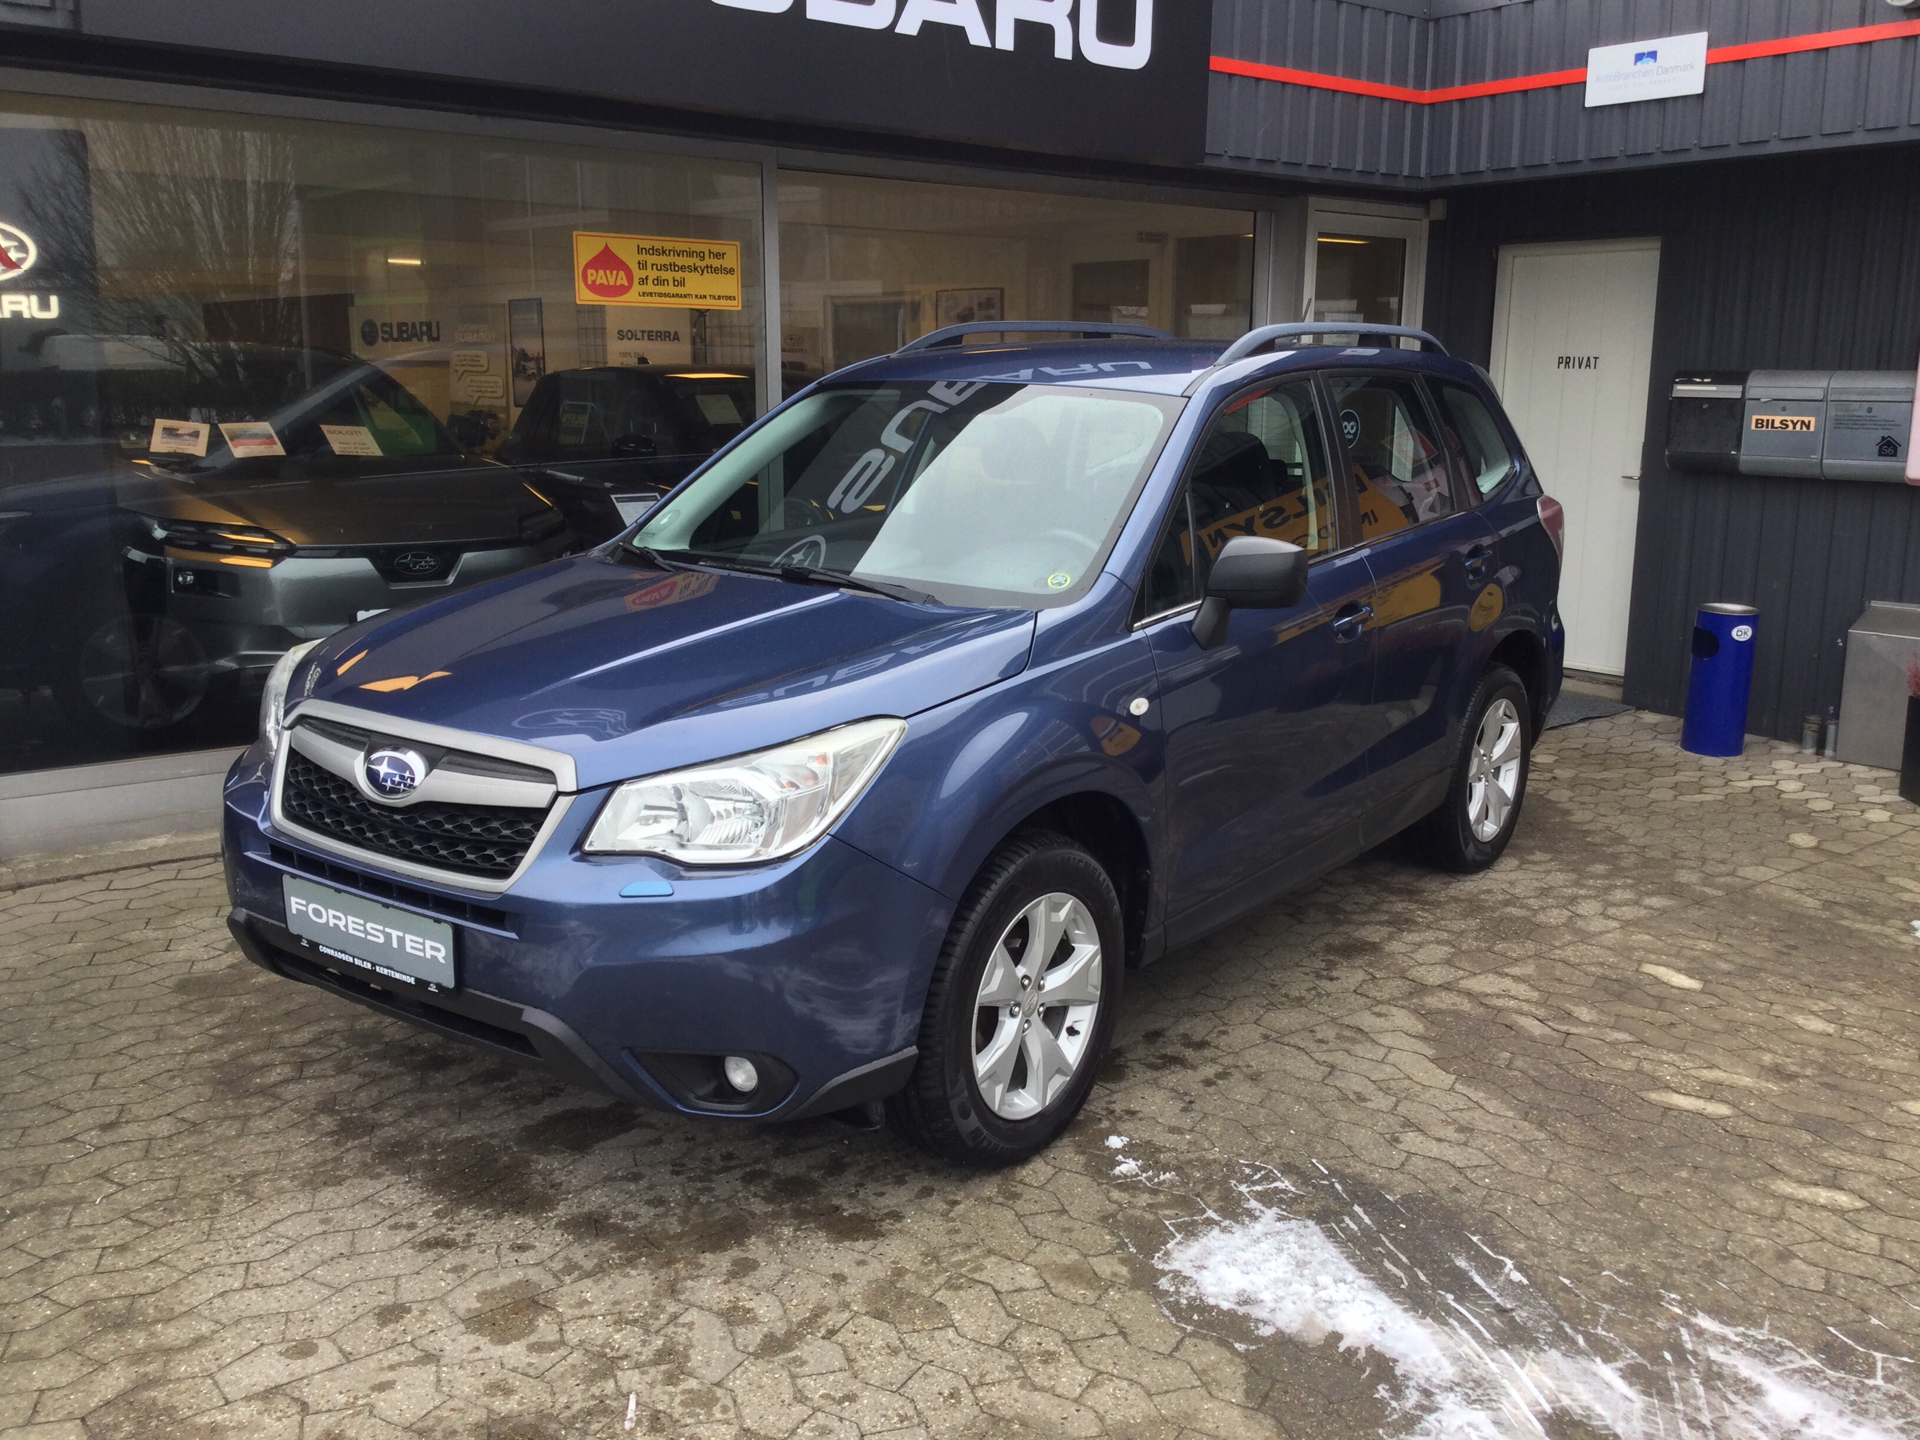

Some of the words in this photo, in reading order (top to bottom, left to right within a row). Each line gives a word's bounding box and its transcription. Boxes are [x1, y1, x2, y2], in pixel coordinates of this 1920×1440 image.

[1595, 69, 1653, 83] AutoBranchen
[1657, 62, 1695, 75] Danmark
[637, 244, 705, 260] Indskrivning
[708, 249, 727, 260] her
[638, 260, 647, 270] til
[651, 261, 735, 277] rustbeskyttelse
[587, 269, 629, 287] PAVA
[638, 275, 649, 286] af
[652, 276, 670, 287] din
[672, 276, 686, 288] bil
[638, 291, 693, 300] LEVETIDSGARANTI
[708, 294, 737, 302] TILBYDES
[380, 321, 441, 343] SUBARU
[617, 329, 681, 342] SOLTERRA
[1557, 356, 1600, 370] PRIVAT
[1754, 418, 1812, 431] BILSYN
[1881, 445, 1894, 455] 56
[1736, 629, 1750, 637] DK
[290, 896, 446, 964] FORESTER
[318, 944, 354, 964] CONRADSEN
[354, 957, 372, 971] BILER
[375, 965, 416, 985] KERTEMINDE
